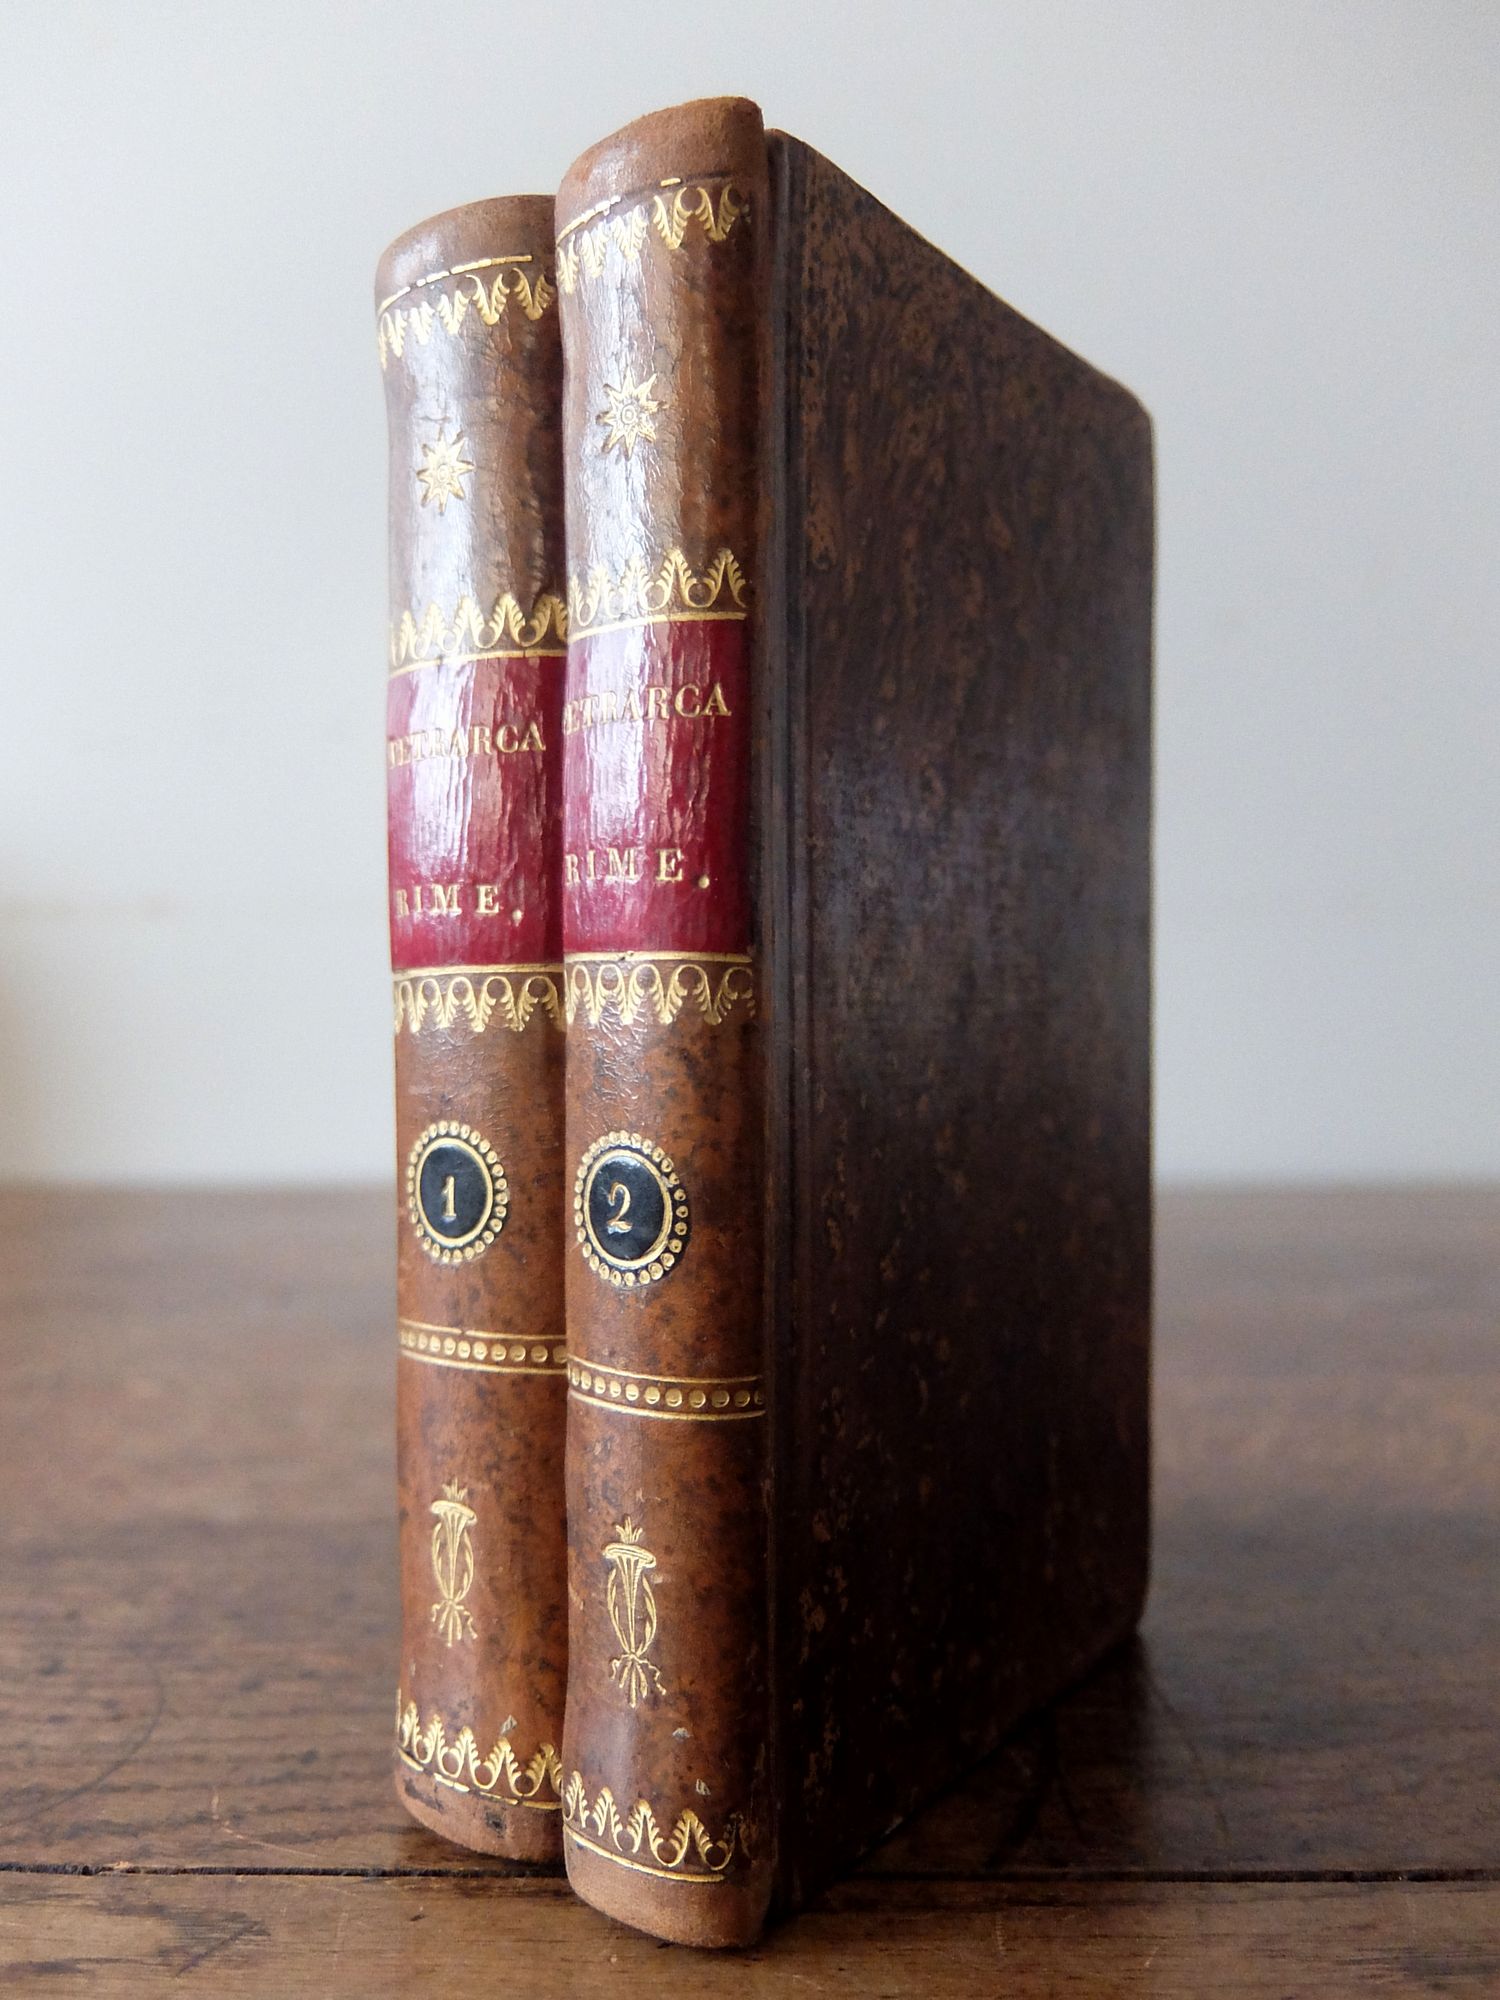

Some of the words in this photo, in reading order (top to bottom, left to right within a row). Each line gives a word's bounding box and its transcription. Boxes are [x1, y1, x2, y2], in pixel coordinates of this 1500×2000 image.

[563, 682, 732, 734] ETRARCA
[441, 1175, 457, 1221] 1
[606, 1182, 632, 1234] 2
